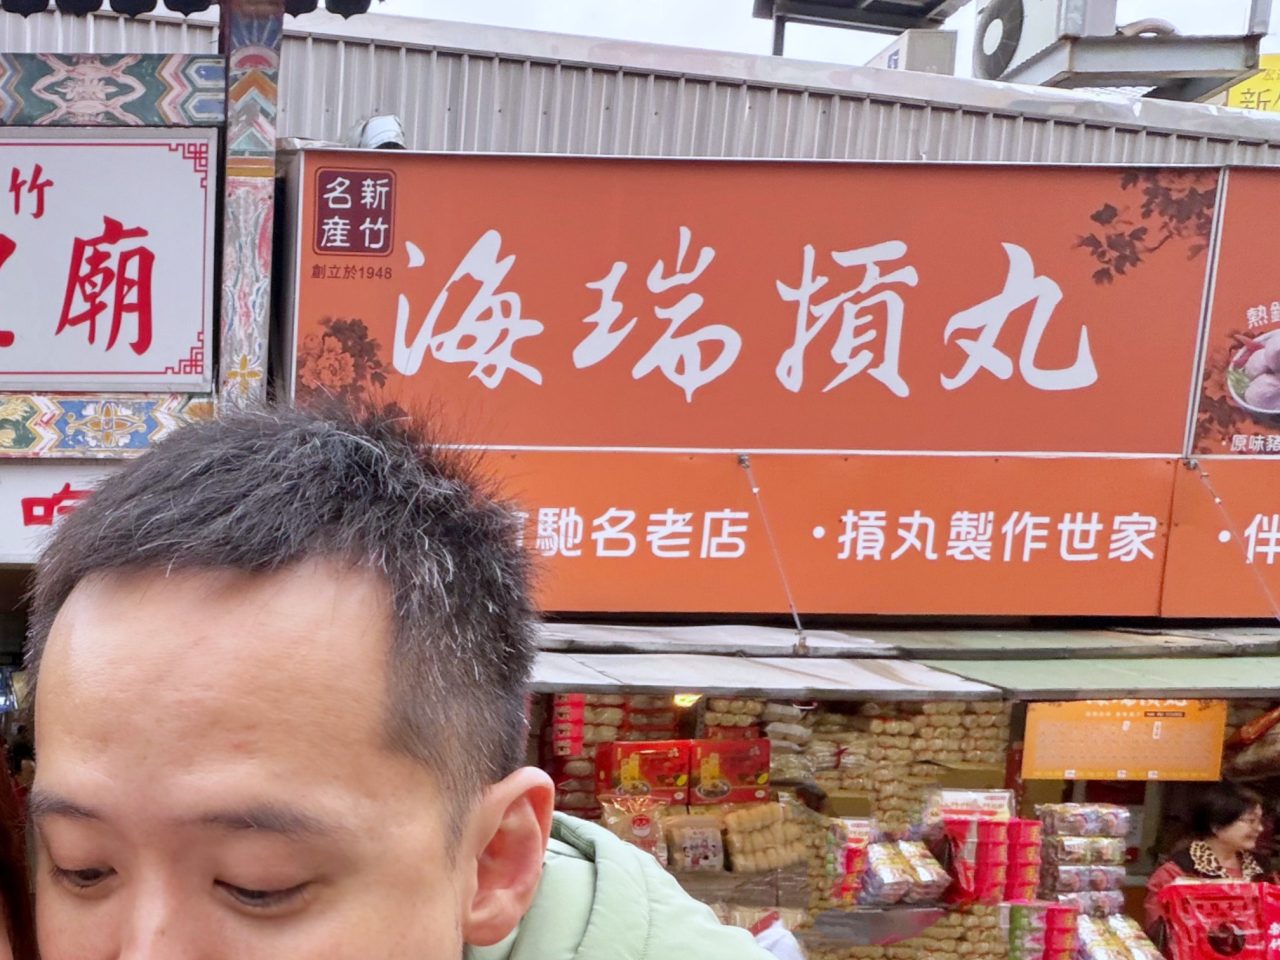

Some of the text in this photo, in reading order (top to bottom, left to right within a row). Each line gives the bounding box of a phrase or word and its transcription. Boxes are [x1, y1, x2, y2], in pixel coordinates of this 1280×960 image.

[1240, 88, 1280, 111] 新
[311, 264, 393, 280] 創立於1948
